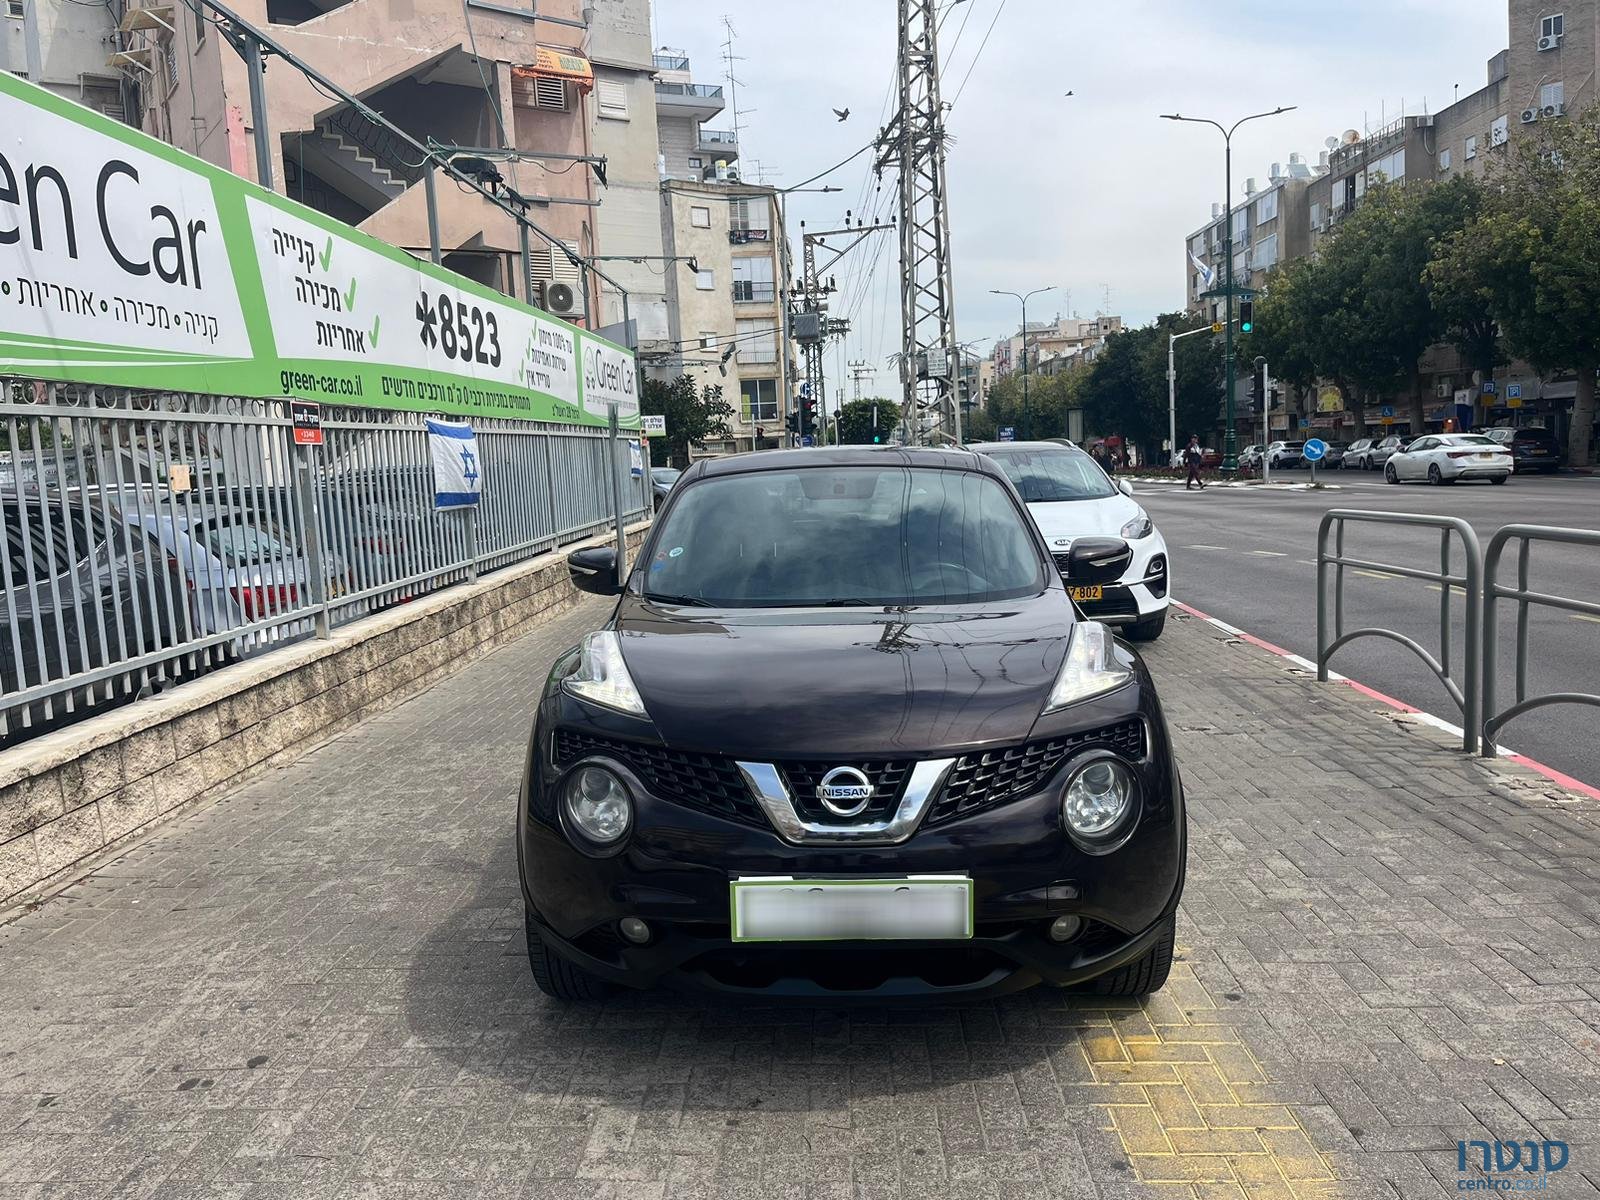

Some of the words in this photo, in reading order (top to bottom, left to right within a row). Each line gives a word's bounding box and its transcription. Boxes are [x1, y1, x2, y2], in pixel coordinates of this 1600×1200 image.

[96, 159, 207, 290] Car
[272, 227, 315, 273] קנייה
[17, 277, 96, 317] אחריות
[294, 275, 342, 312] מכירה
[114, 296, 170, 330] מכירה
[184, 311, 219, 344] קניה
[316, 320, 367, 354] אחריות
[281, 371, 363, 394] green-car.co.il
[381, 376, 416, 399] חדשים
[595, 348, 620, 392] Green
[621, 358, 634, 395] Car
[417, 381, 445, 402] ורכבים
[822, 788, 869, 797] NISSAN
